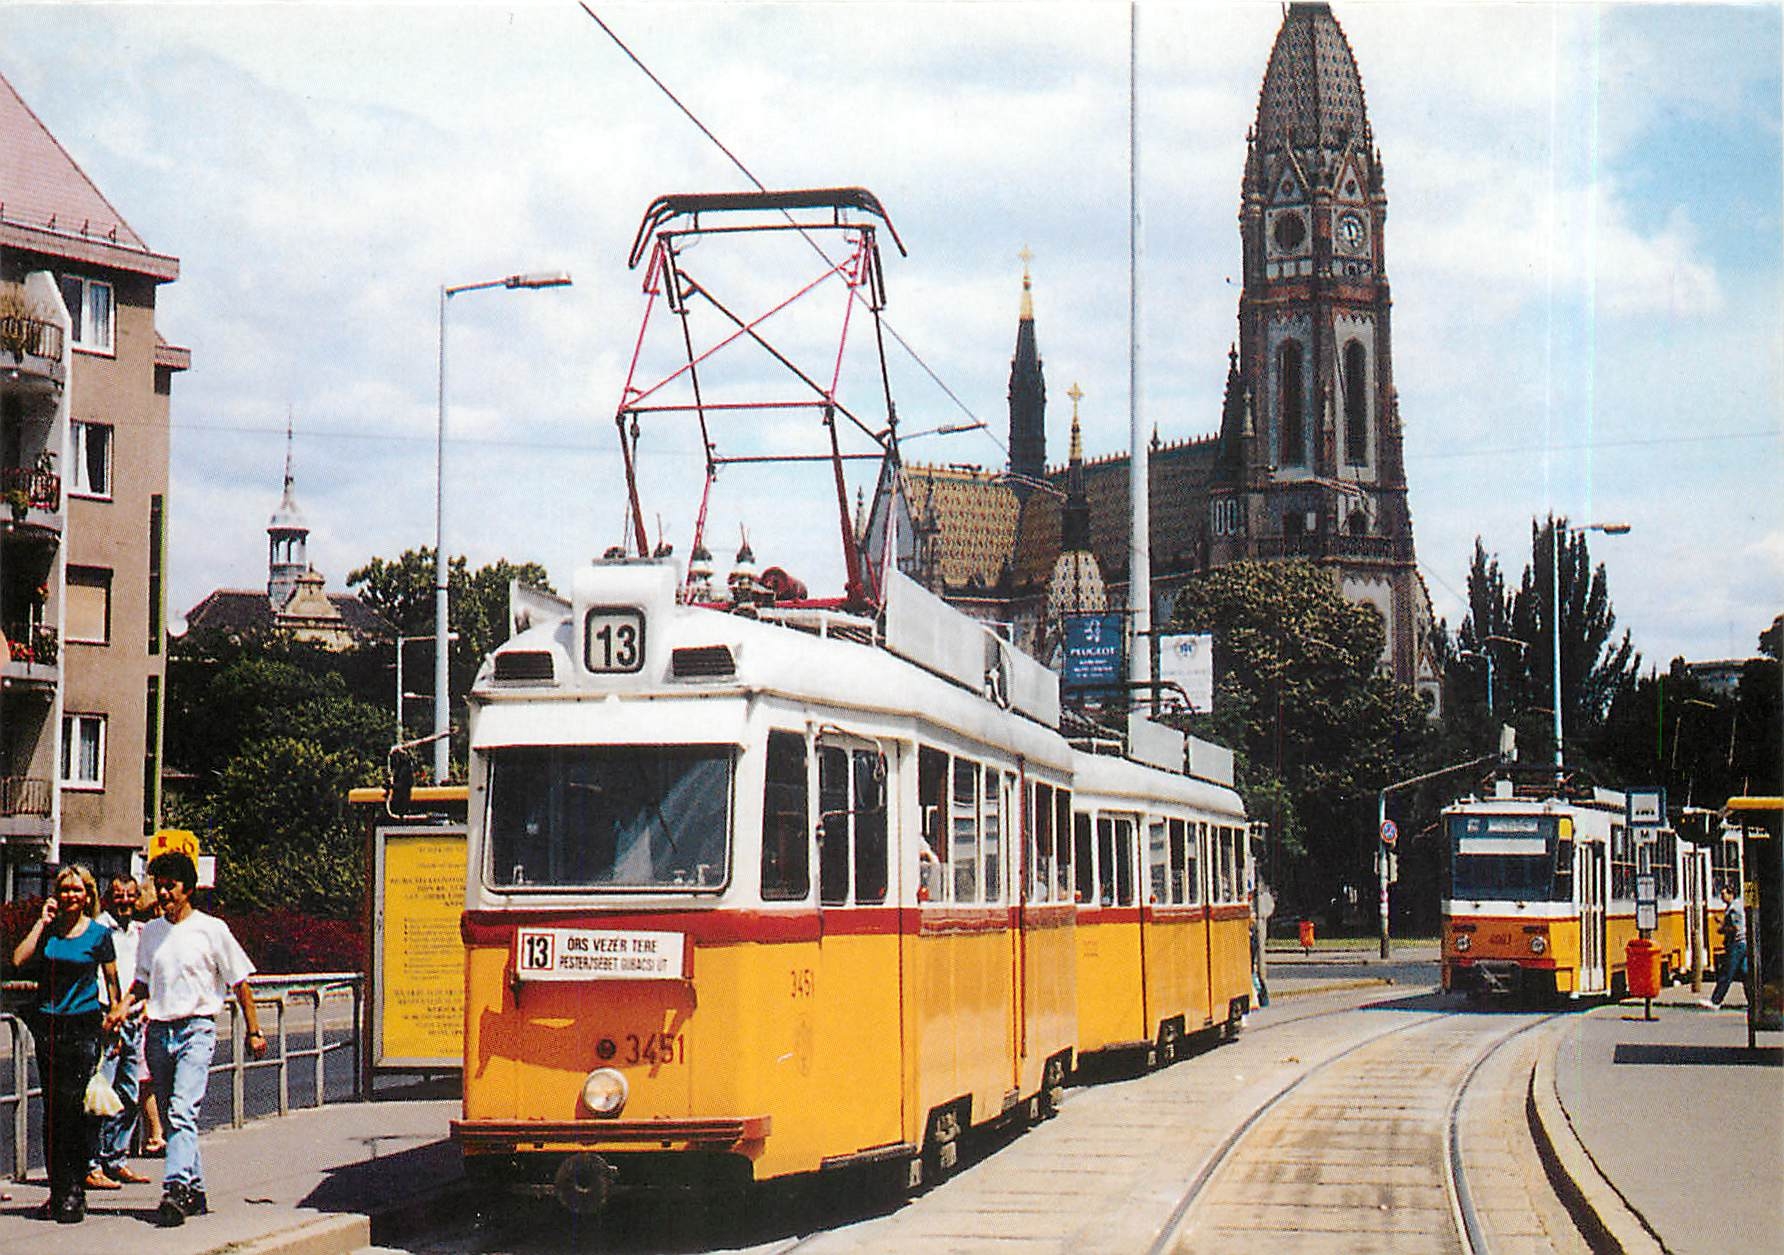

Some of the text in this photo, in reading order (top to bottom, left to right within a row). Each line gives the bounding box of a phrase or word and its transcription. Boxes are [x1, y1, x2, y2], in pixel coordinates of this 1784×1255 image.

[596, 624, 636, 667] 13
[526, 937, 549, 969] 13
[791, 968, 815, 998] 3451
[625, 1033, 684, 1065] 3451
